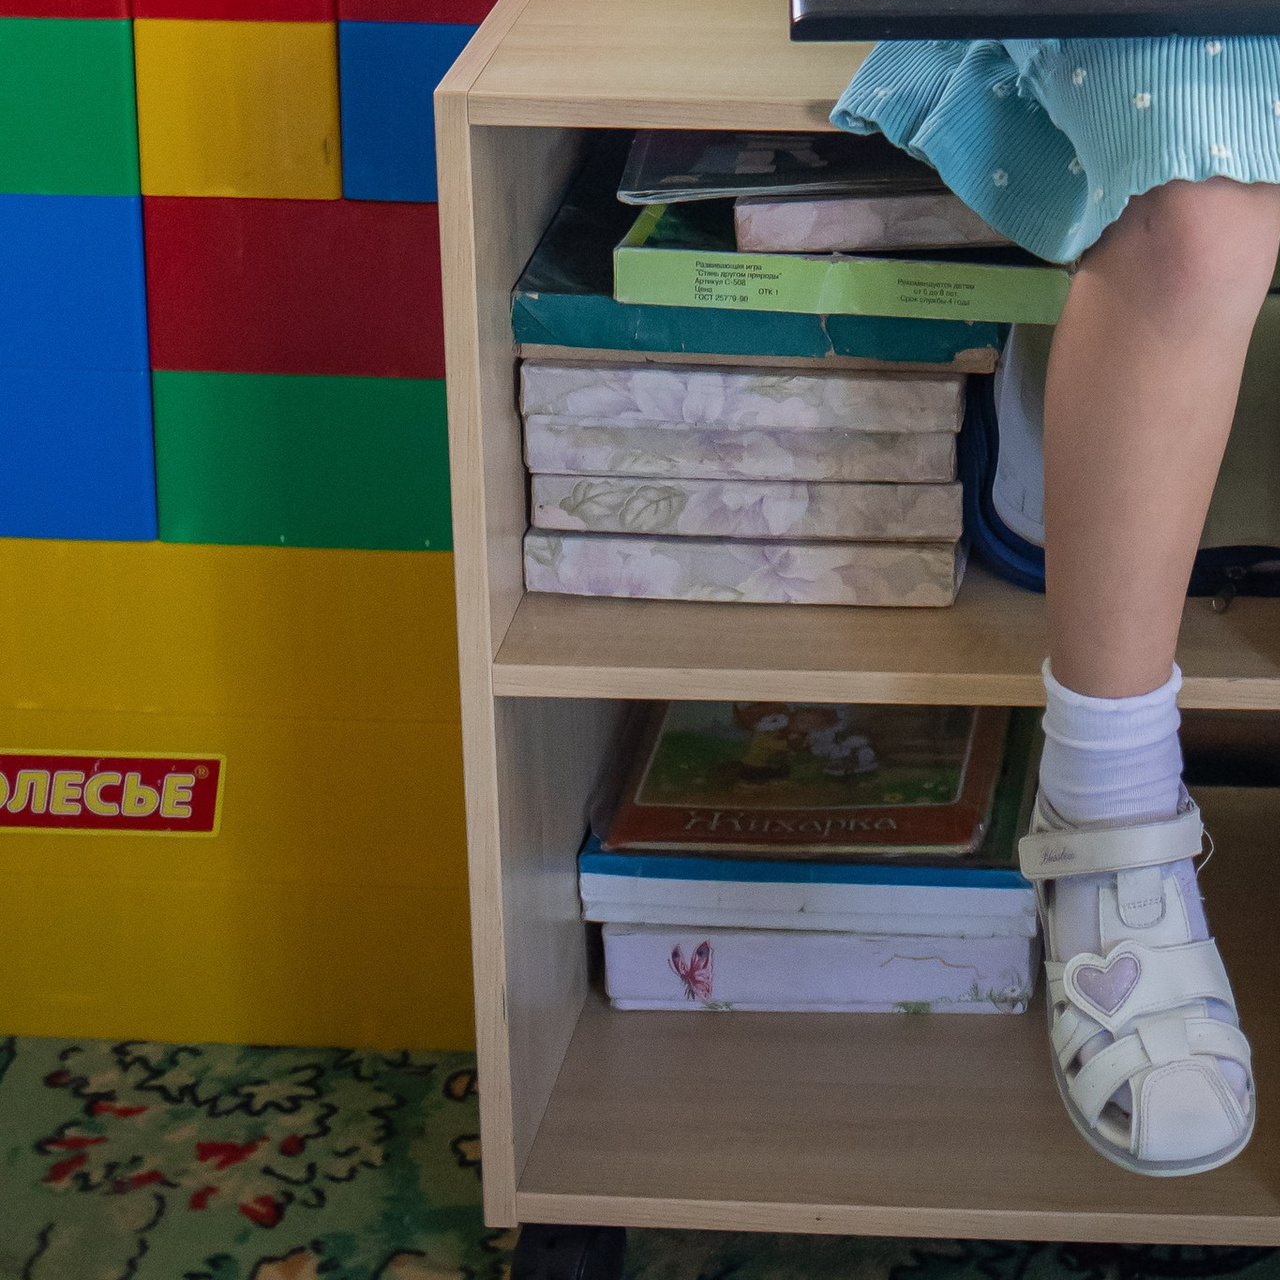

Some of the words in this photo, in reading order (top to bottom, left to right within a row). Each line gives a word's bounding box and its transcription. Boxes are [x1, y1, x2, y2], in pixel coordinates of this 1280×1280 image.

[720, 271, 746, 279] другом
[695, 277, 723, 286] Артикул
[0, 769, 195, 818] ЛЕСЬЕ
